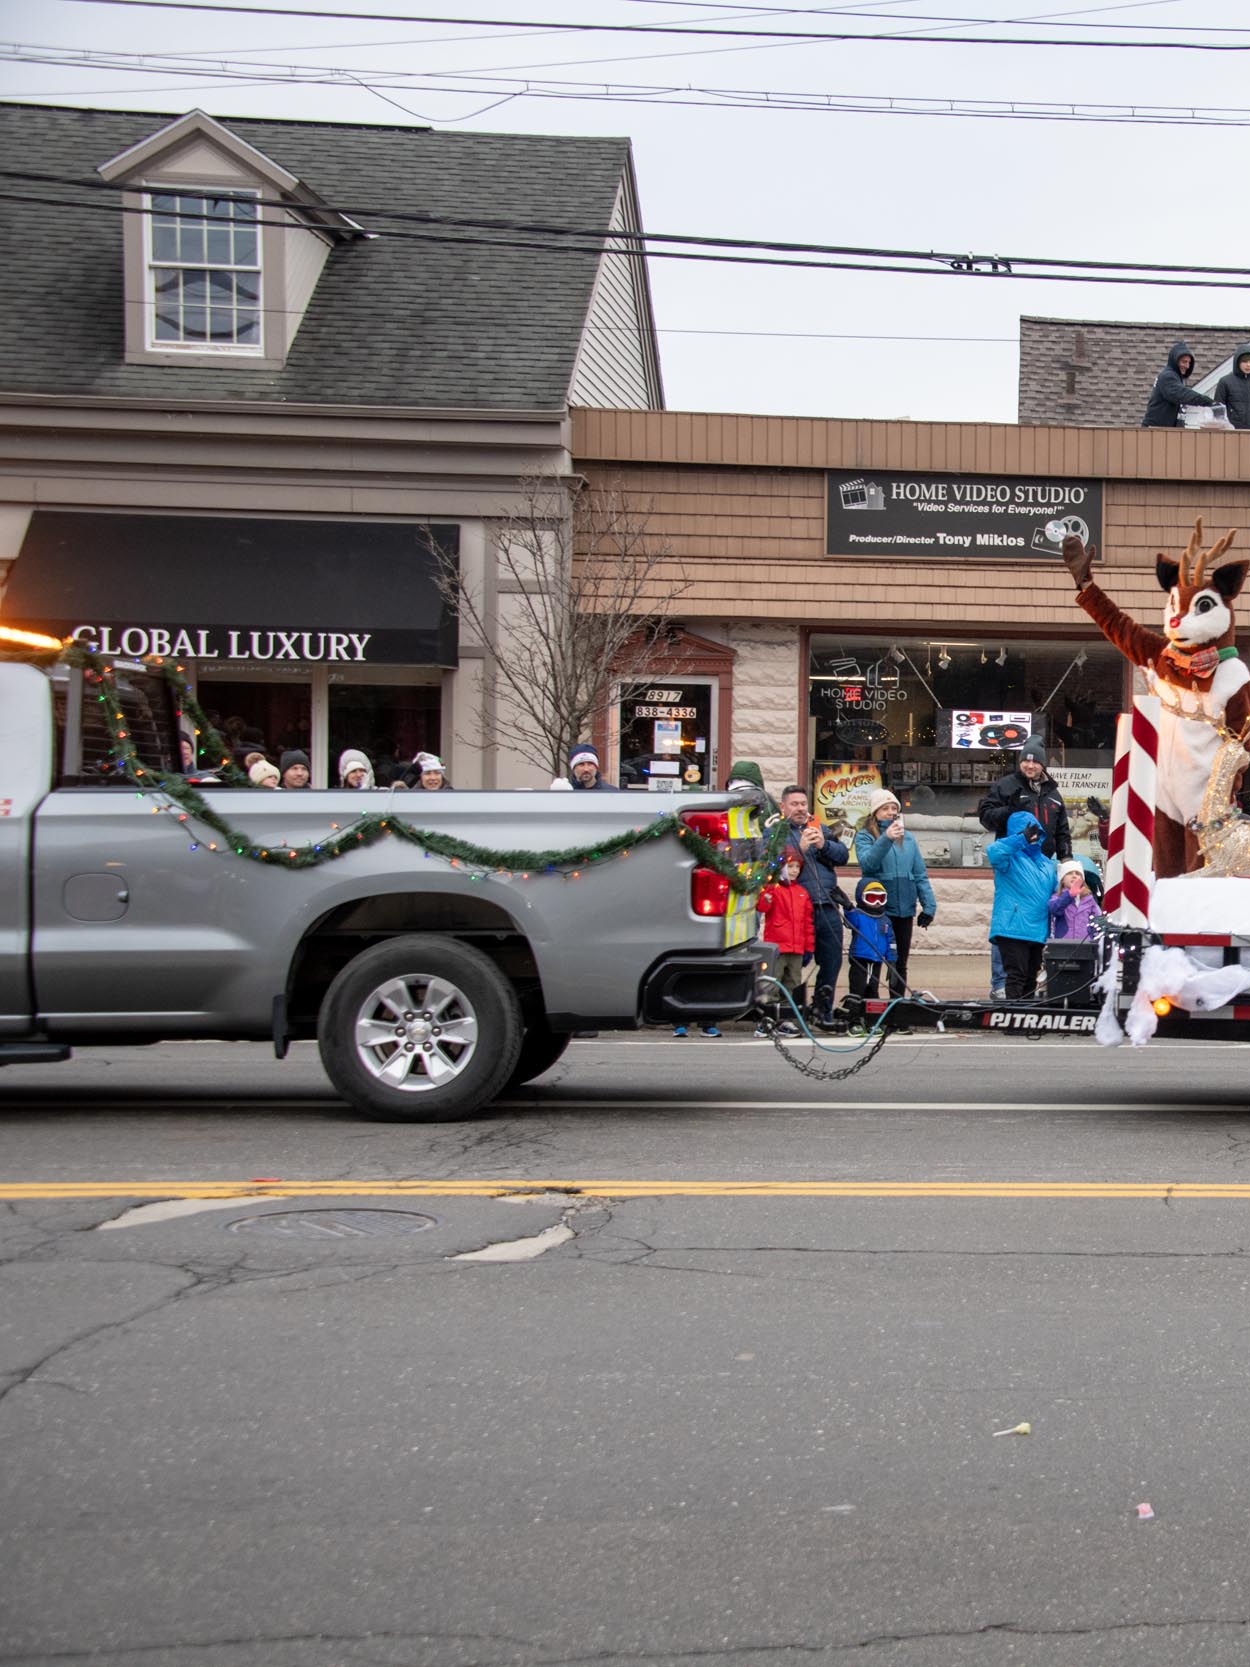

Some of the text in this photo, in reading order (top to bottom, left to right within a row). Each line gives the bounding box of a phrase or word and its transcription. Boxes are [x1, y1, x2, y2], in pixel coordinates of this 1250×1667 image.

[891, 482, 1085, 504] HOME VIDEO STUDIO
[912, 502, 945, 512] "Video
[947, 503, 990, 513] Services
[991, 504, 1006, 514] for
[849, 532, 1026, 547] Producer/Director Tony Miklos
[72, 625, 372, 661] GLOBAL LUXURY
[647, 691, 682, 701] 8917
[821, 688, 907, 701] HOME VIDEO
[836, 699, 887, 711] STUDIO
[636, 707, 696, 718] 838-4336
[1070, 772, 1092, 780] FILM?
[1072, 780, 1110, 789] TRANSFER!
[990, 1012, 1013, 1027] PJ
